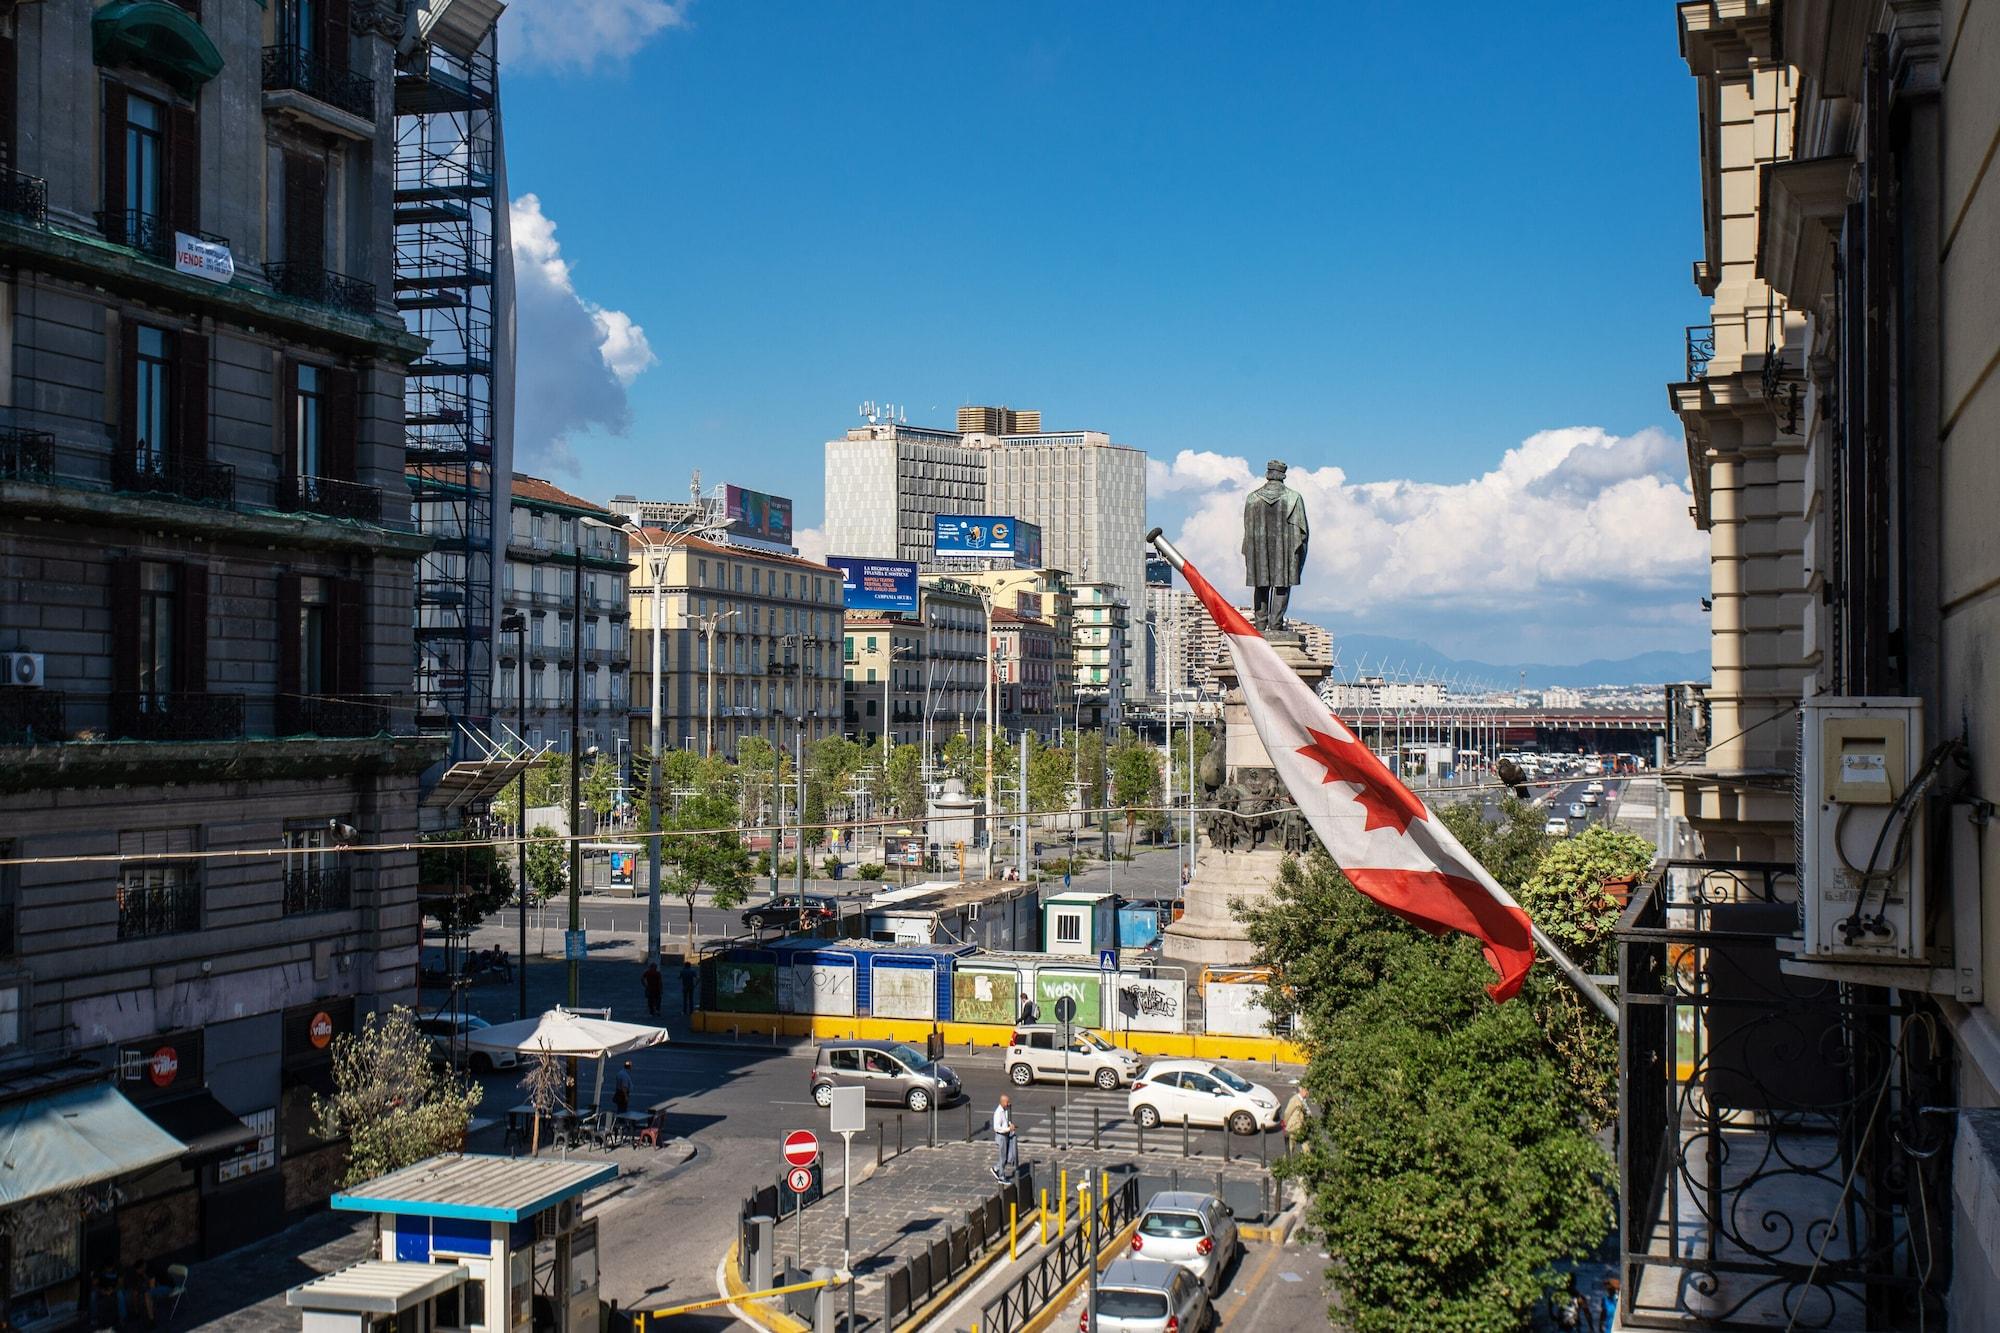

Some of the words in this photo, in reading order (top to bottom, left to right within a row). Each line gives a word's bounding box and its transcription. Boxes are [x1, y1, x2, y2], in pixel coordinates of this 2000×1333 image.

[178, 251, 203, 267] VENDE
[313, 1021, 332, 1036] villa
[154, 1056, 178, 1075] villa
